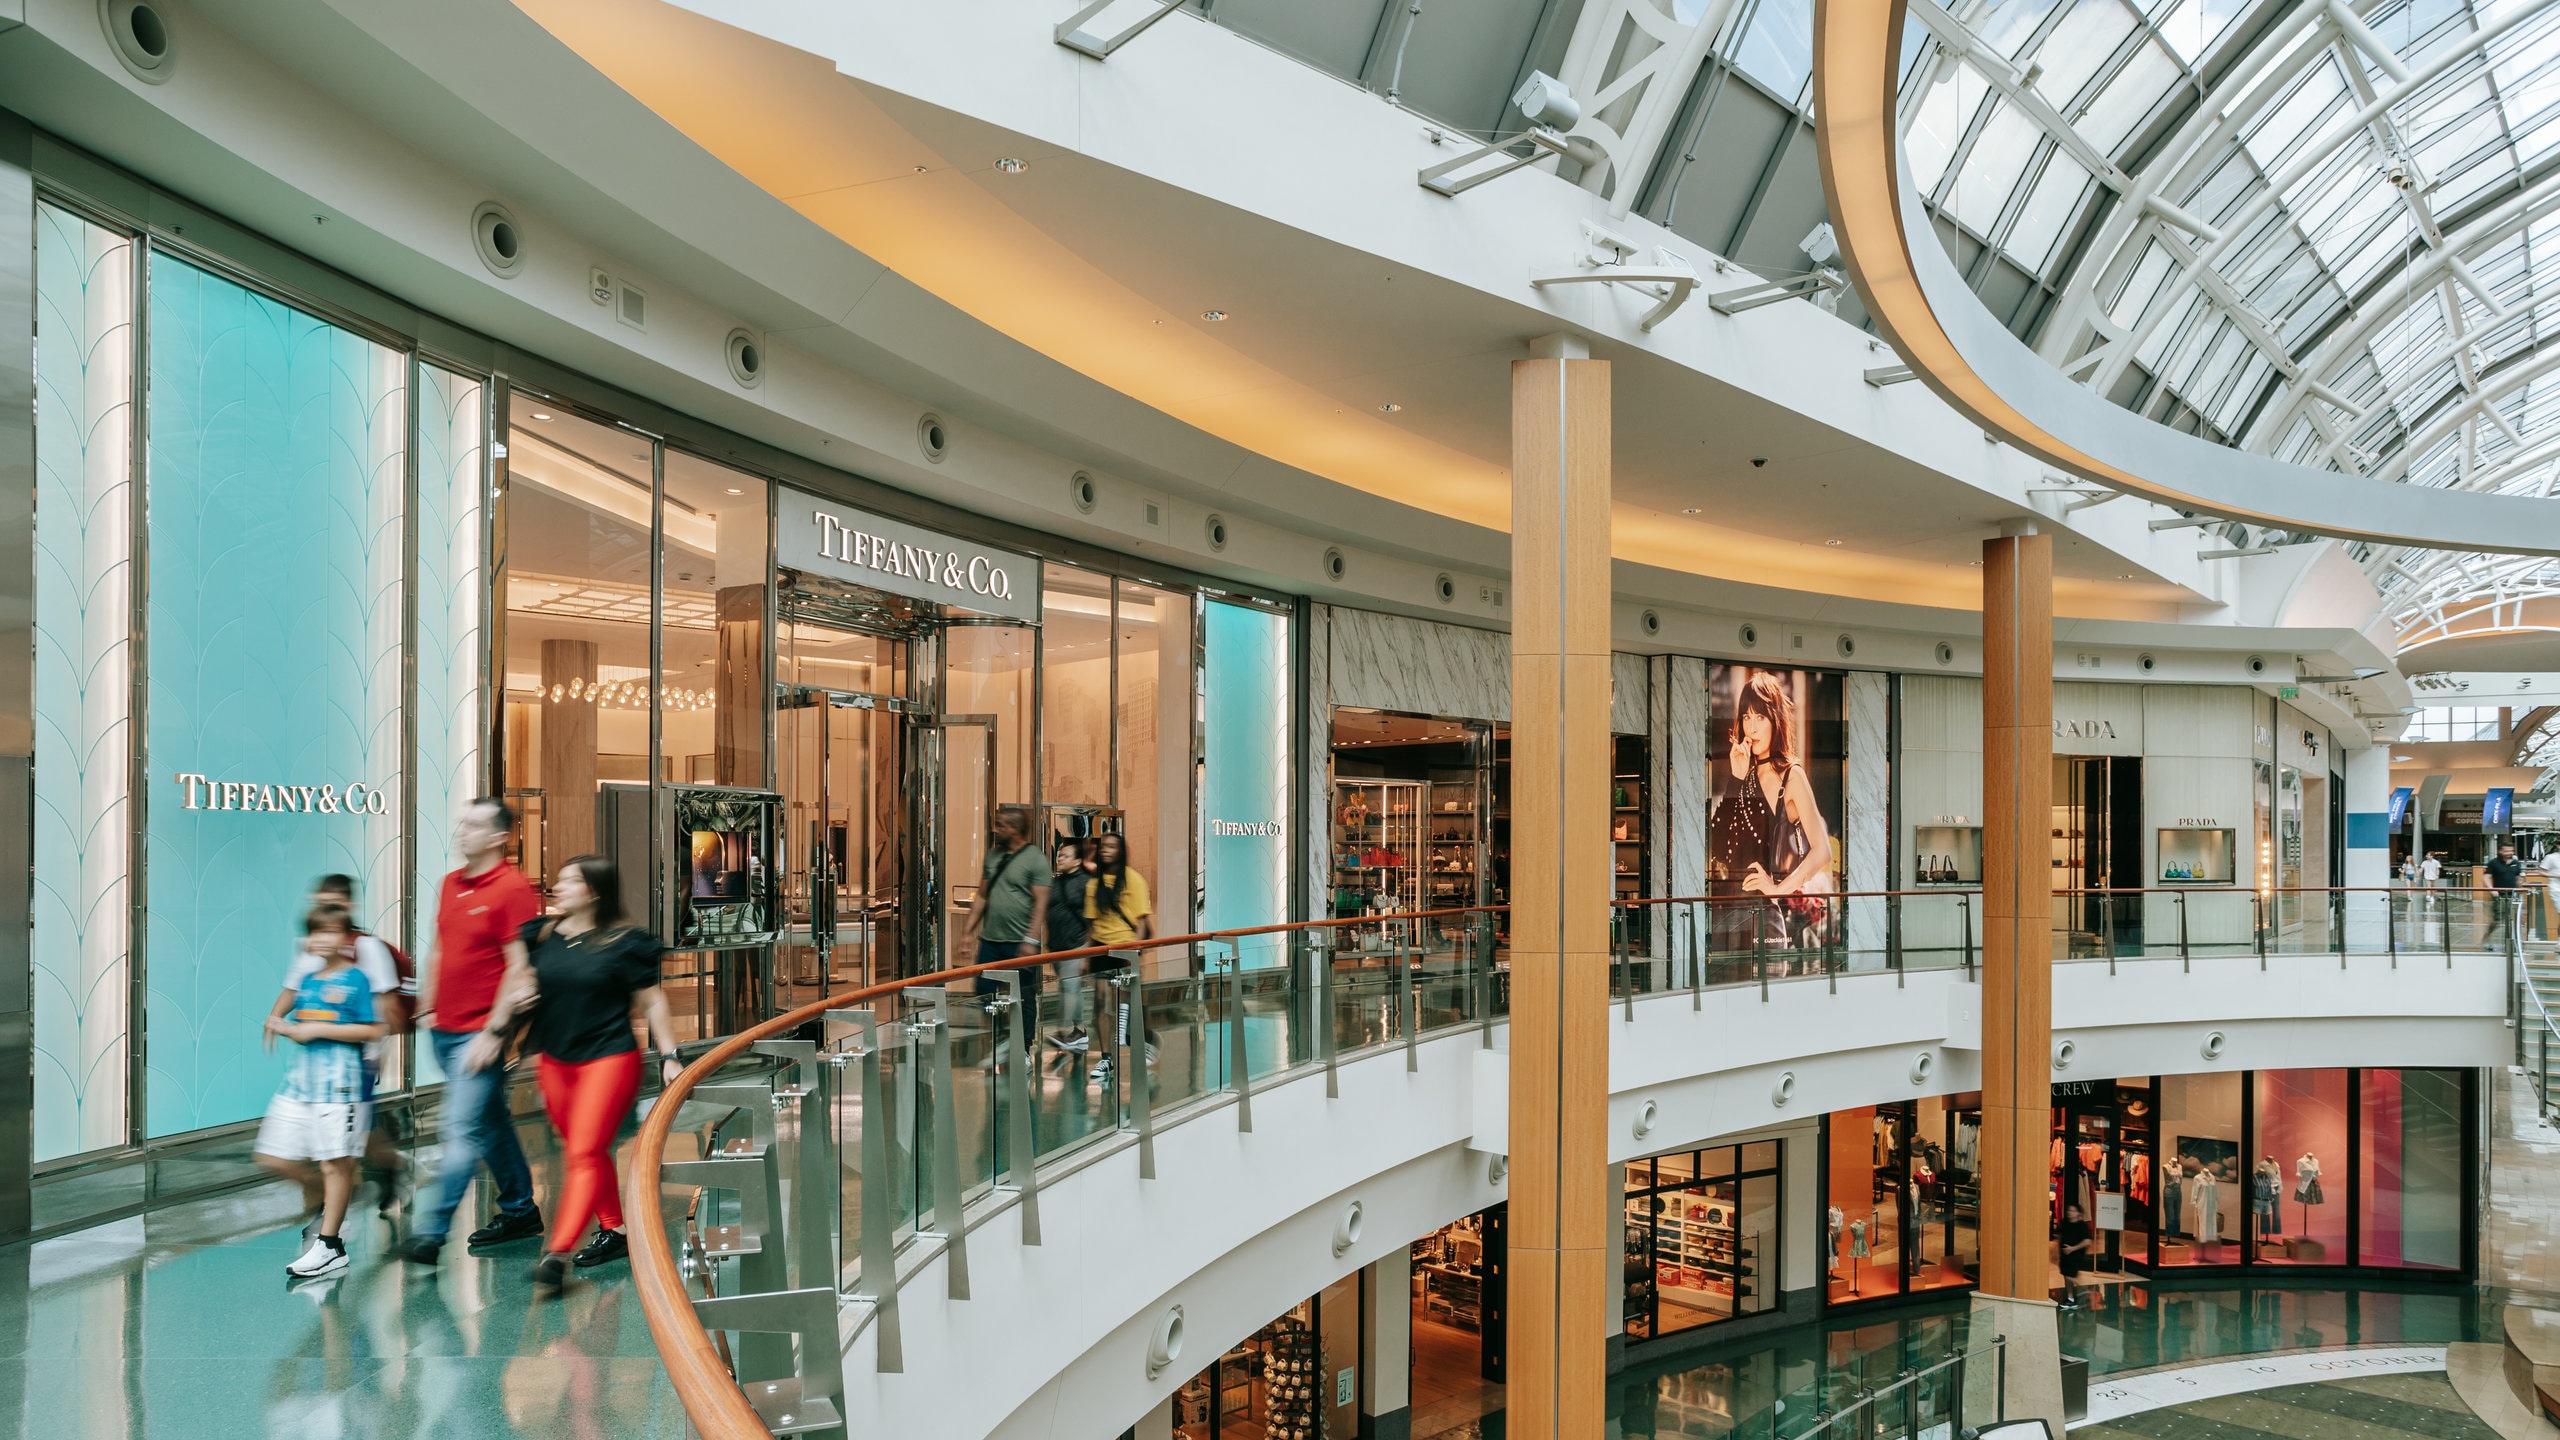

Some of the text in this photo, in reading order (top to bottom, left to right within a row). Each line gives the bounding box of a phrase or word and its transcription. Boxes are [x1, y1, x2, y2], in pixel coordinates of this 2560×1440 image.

[2052, 719, 2117, 739] RADA
[2179, 818, 2217, 826] PRADA
[2447, 811, 2483, 819] STARBUC
[2052, 1082, 2095, 1097] CREW
[2096, 1389, 2128, 1401] 30
[2176, 1376, 2198, 1386] 5
[2309, 1355, 2444, 1371] OCTOBER
